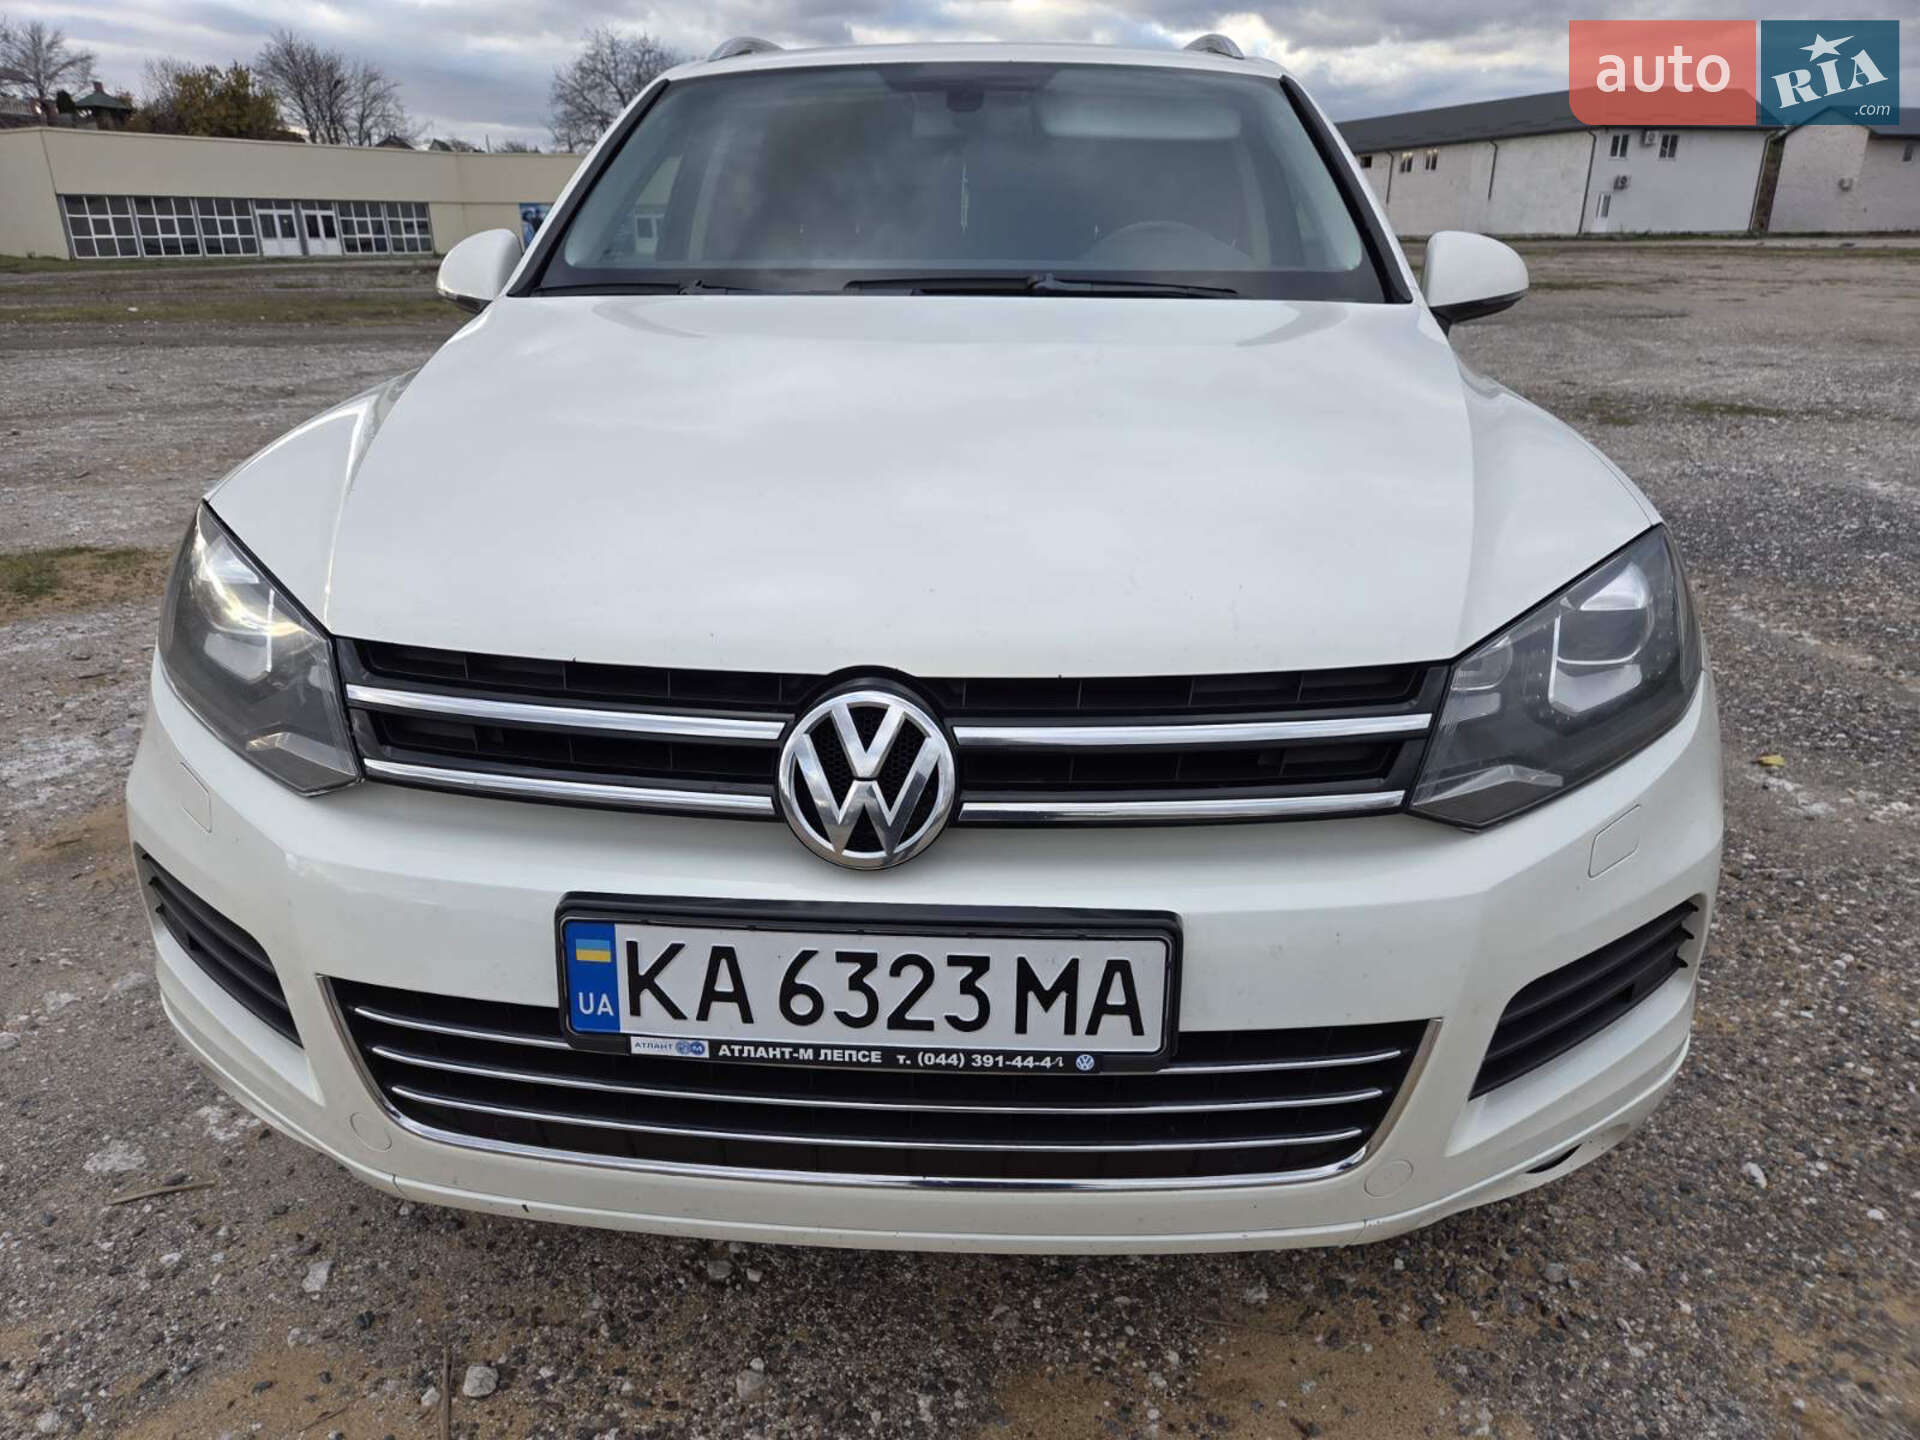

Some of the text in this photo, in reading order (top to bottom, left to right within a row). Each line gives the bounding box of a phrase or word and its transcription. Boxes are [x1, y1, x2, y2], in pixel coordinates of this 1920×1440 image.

[626, 940, 1145, 1036] KA 6323 MA
[578, 991, 614, 1016] UA
[718, 1044, 814, 1061] АТЛАНТ-М
[818, 1050, 883, 1063] ЛЕПСЕ
[917, 1051, 965, 1069] (044)
